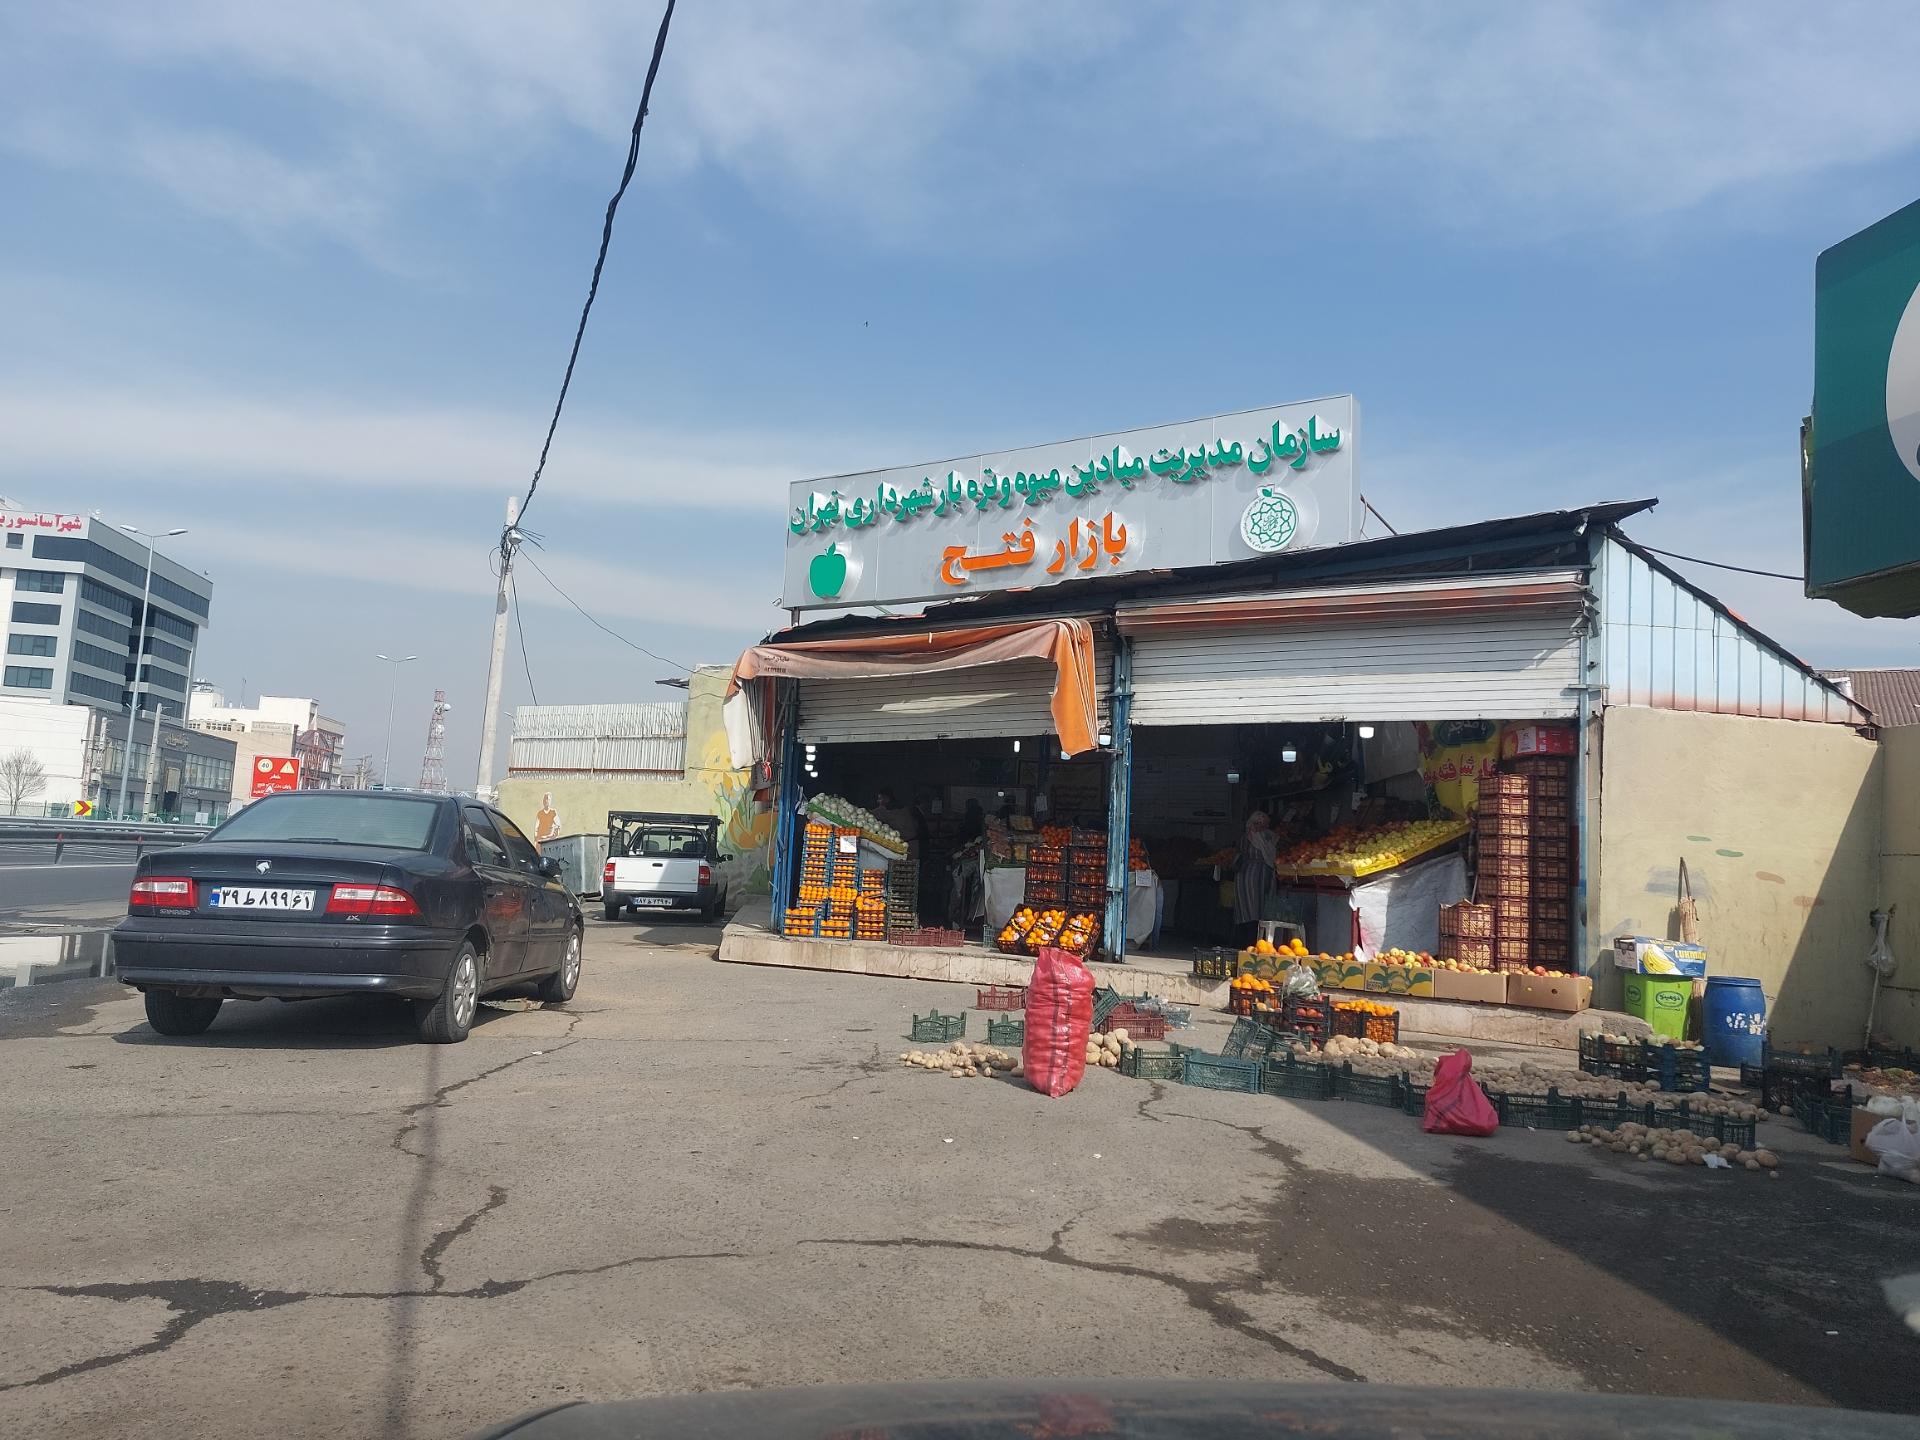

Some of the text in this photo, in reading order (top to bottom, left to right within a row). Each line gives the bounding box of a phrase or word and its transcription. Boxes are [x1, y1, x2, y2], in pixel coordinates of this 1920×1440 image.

[1149, 437, 1243, 482] مدیریت
[1247, 414, 1341, 474] سازمان
[1015, 468, 1060, 505] میوه
[1065, 445, 1144, 497] میادین
[790, 489, 840, 535] تهران
[844, 476, 933, 528] شهرداری
[1046, 511, 1127, 574] بازار
[259, 890, 289, 907] ۸۹۹
